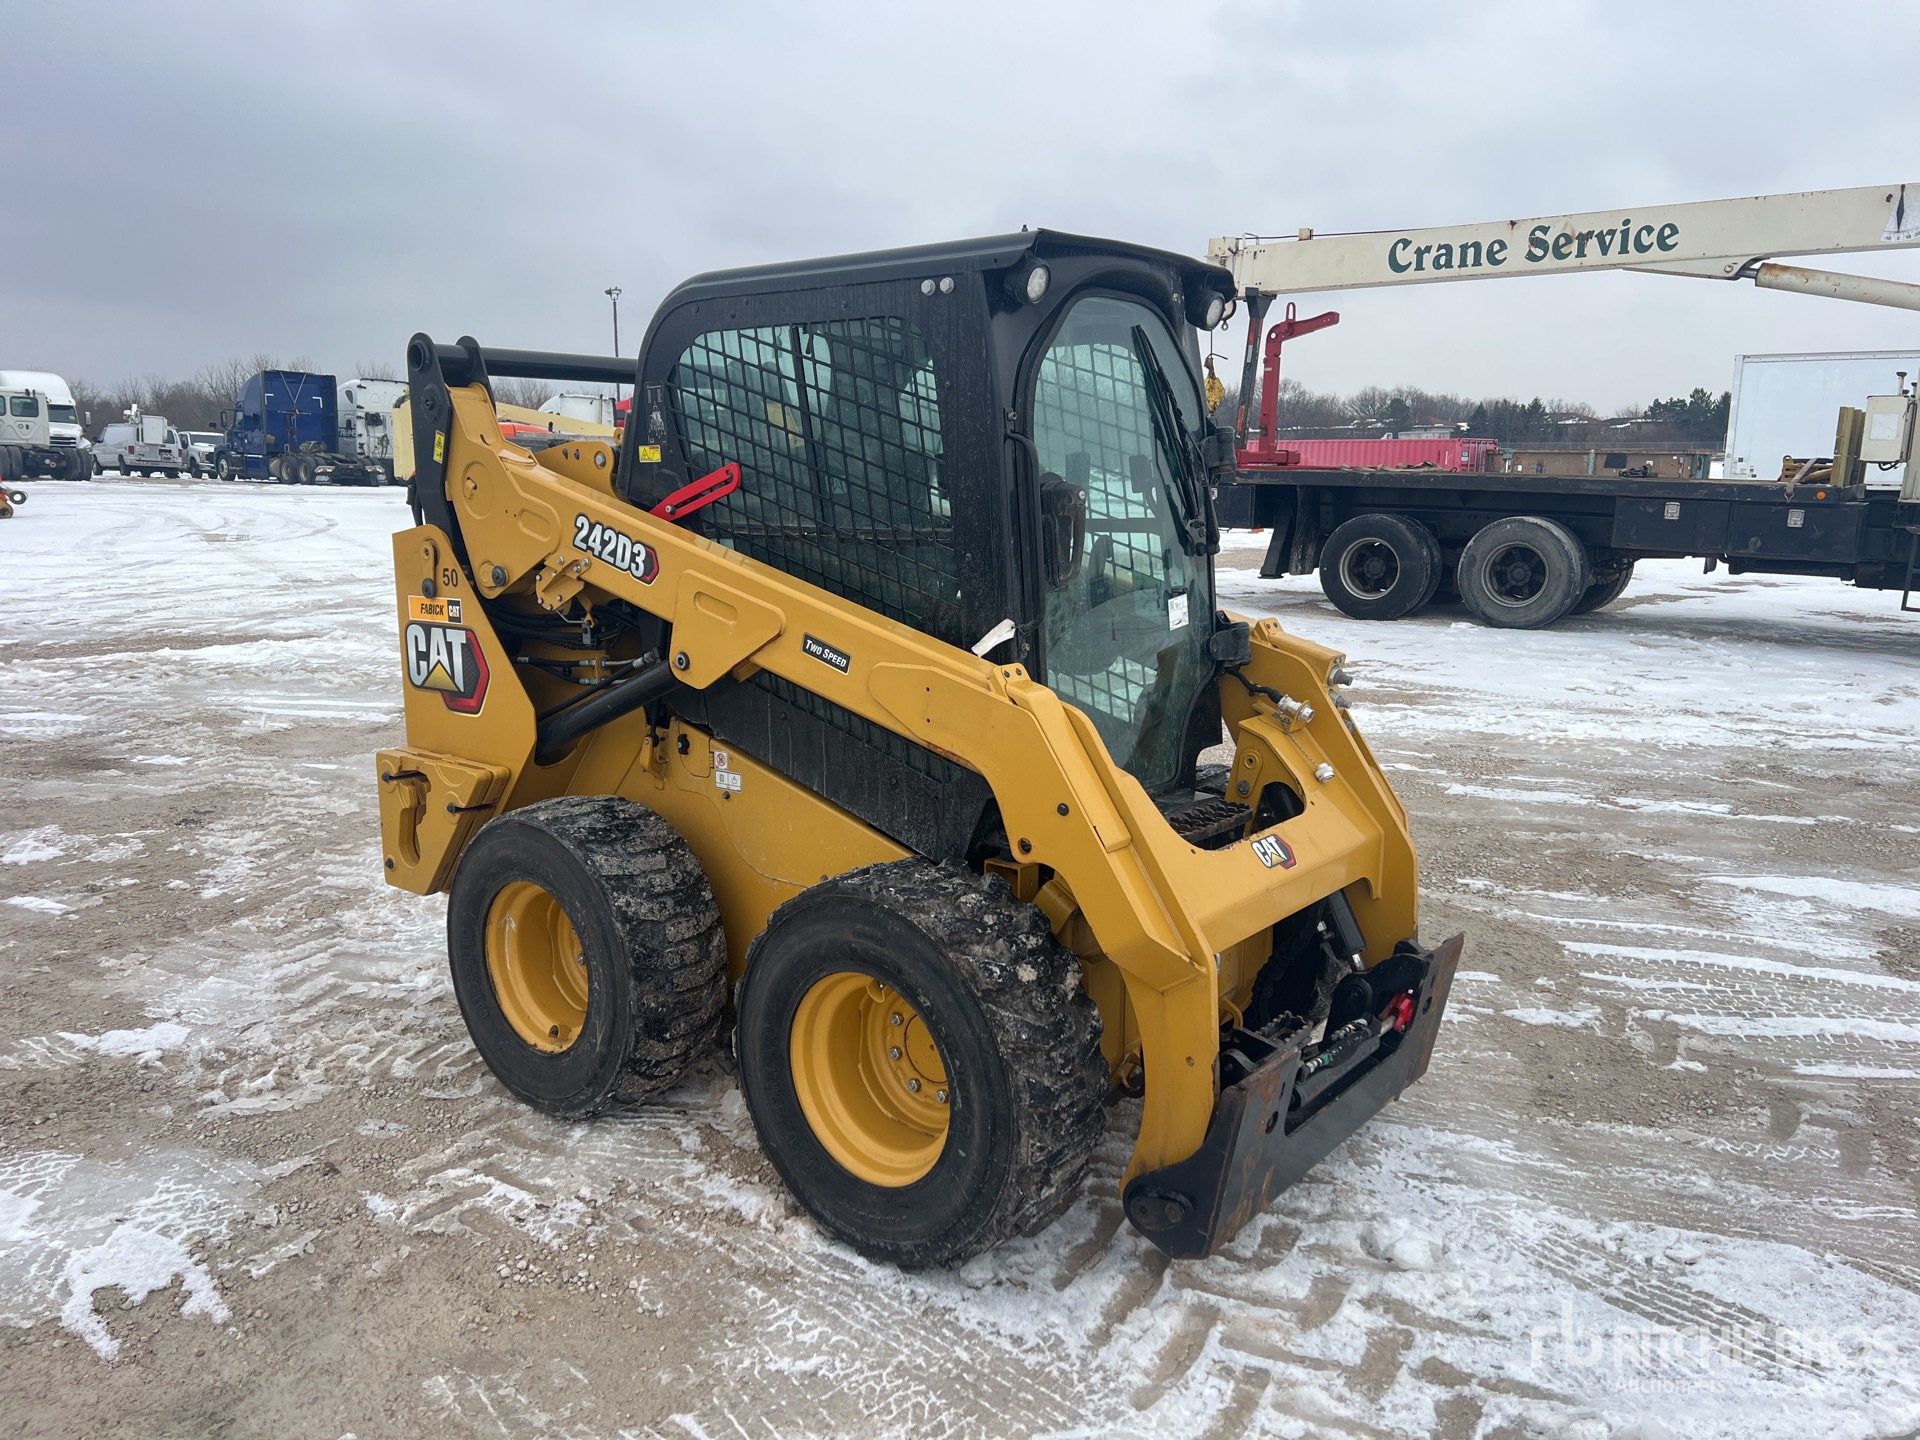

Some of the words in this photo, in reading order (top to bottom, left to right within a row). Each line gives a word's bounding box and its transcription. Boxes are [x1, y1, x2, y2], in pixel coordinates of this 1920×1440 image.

[1387, 237, 1508, 274] Crane
[1524, 217, 1680, 264] Service
[575, 515, 647, 578] 242D3
[442, 567, 459, 588] 50
[420, 603, 445, 616] FABICK
[448, 604, 460, 618] CAT
[406, 624, 466, 693] CAT
[1251, 835, 1288, 868] CAT
